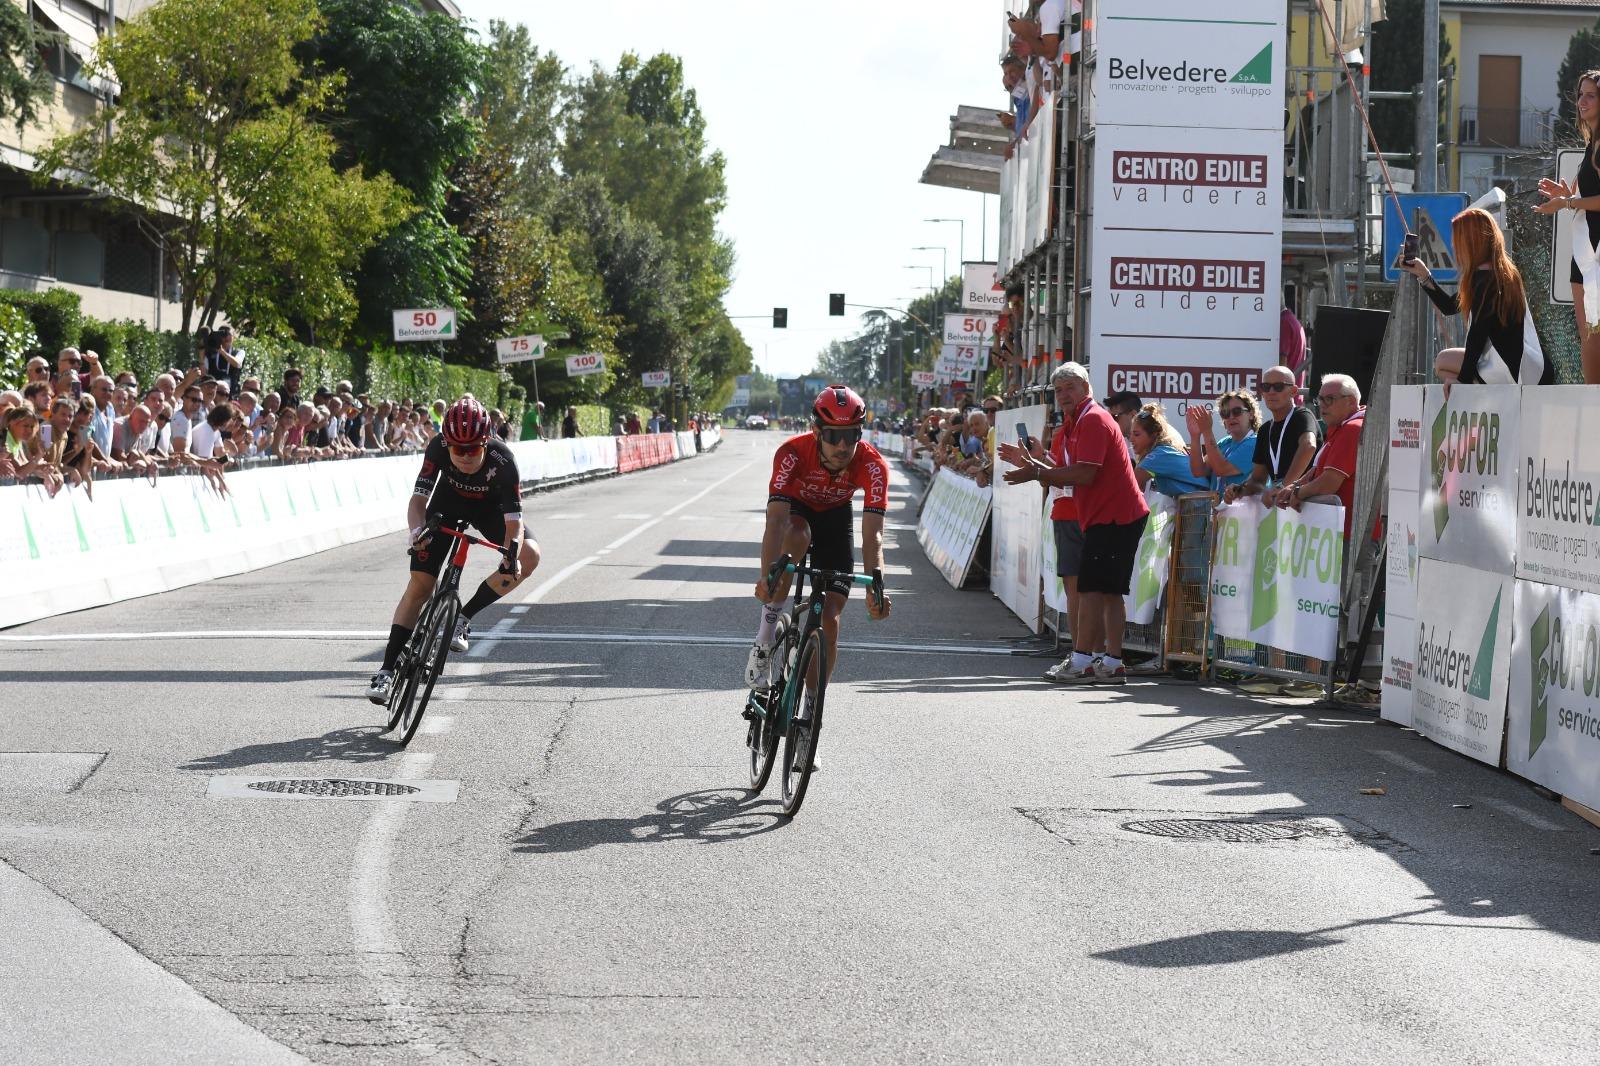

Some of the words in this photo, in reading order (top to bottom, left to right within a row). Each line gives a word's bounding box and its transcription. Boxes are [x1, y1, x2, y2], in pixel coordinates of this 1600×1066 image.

[1109, 58, 1227, 83] Belvedere
[1109, 82, 1168, 92] innovazione
[1178, 84, 1217, 96] progetti
[1231, 86, 1272, 96] sviluppo
[1117, 156, 1199, 181] CENTRO
[1205, 159, 1263, 183] EDILE
[1113, 184, 1267, 206] valdera
[1114, 262, 1196, 287] CENTRO
[1202, 265, 1260, 289] EDILE
[1110, 290, 1264, 312] valdera
[413, 312, 437, 327] 50
[963, 318, 987, 333] 50
[398, 327, 438, 336] Belvedere
[510, 339, 529, 352] 75
[957, 347, 974, 359] 75
[574, 356, 596, 367] 100
[918, 373, 934, 381] 150
[1112, 370, 1193, 395] CENTRO
[1200, 373, 1258, 396] EDILE
[1448, 410, 1500, 476] COFOR
[773, 453, 799, 491] ARKEA
[865, 460, 883, 504] ARKEA
[448, 476, 490, 492] TUDOR
[1527, 456, 1593, 526] Belvedere
[1417, 621, 1471, 693] Belvedere
